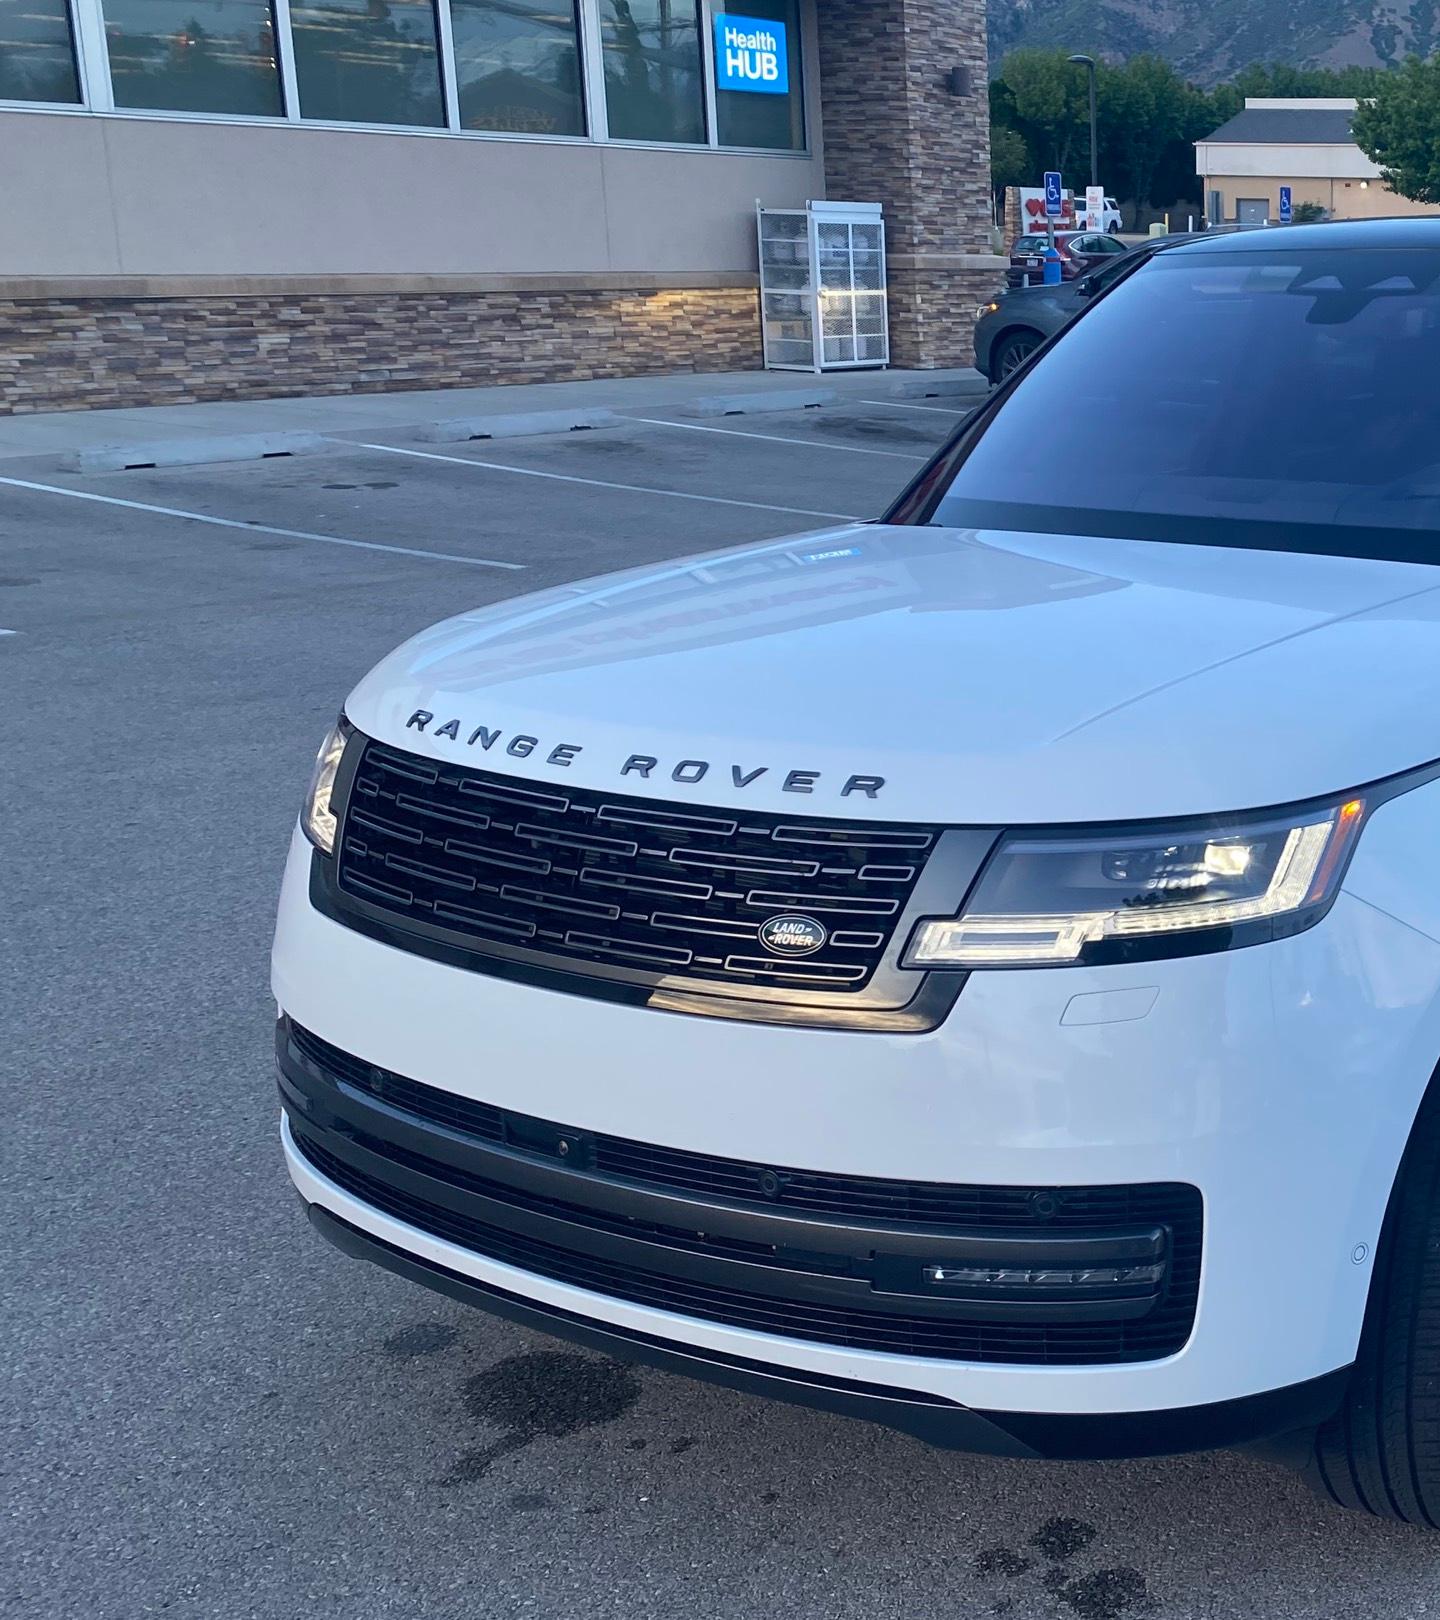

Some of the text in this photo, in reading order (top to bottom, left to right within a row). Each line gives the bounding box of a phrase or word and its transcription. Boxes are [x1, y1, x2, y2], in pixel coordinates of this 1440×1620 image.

[725, 27, 776, 51] Health
[726, 49, 778, 80] HUB
[406, 709, 886, 799] RANGE ROVER
[772, 922, 805, 934] LAND
[773, 933, 813, 946] ROVER
